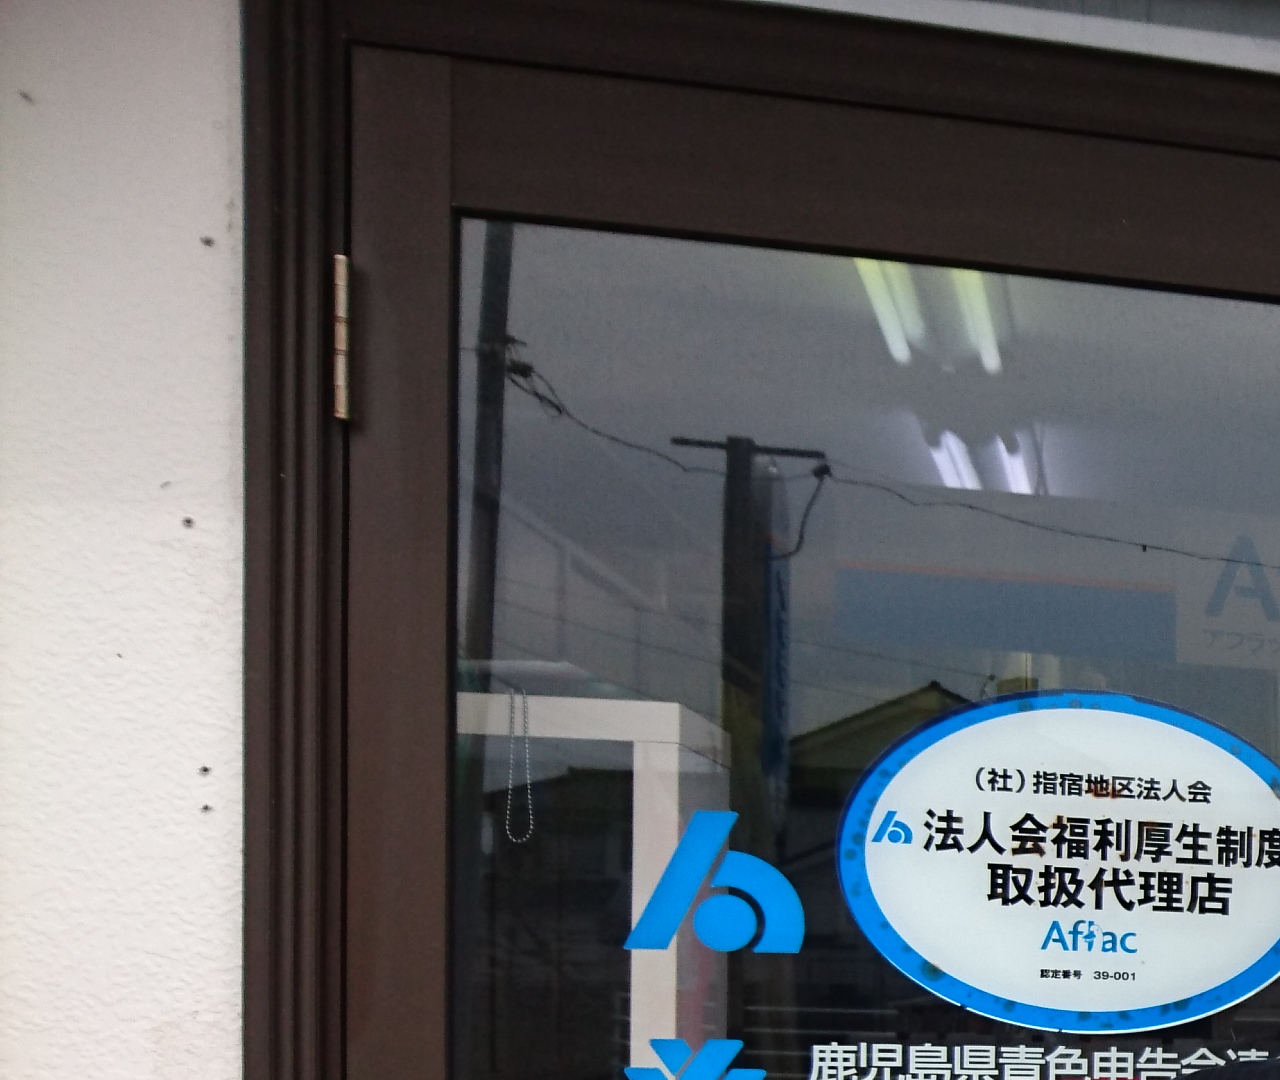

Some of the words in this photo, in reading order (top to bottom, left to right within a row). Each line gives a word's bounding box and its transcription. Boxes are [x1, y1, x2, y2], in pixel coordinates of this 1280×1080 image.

[986, 861, 1235, 917] 取扱代理店
[1040, 919, 1138, 955] Aflac
[1039, 968, 1083, 980] 認定番号
[1093, 970, 1138, 982] 39-001
